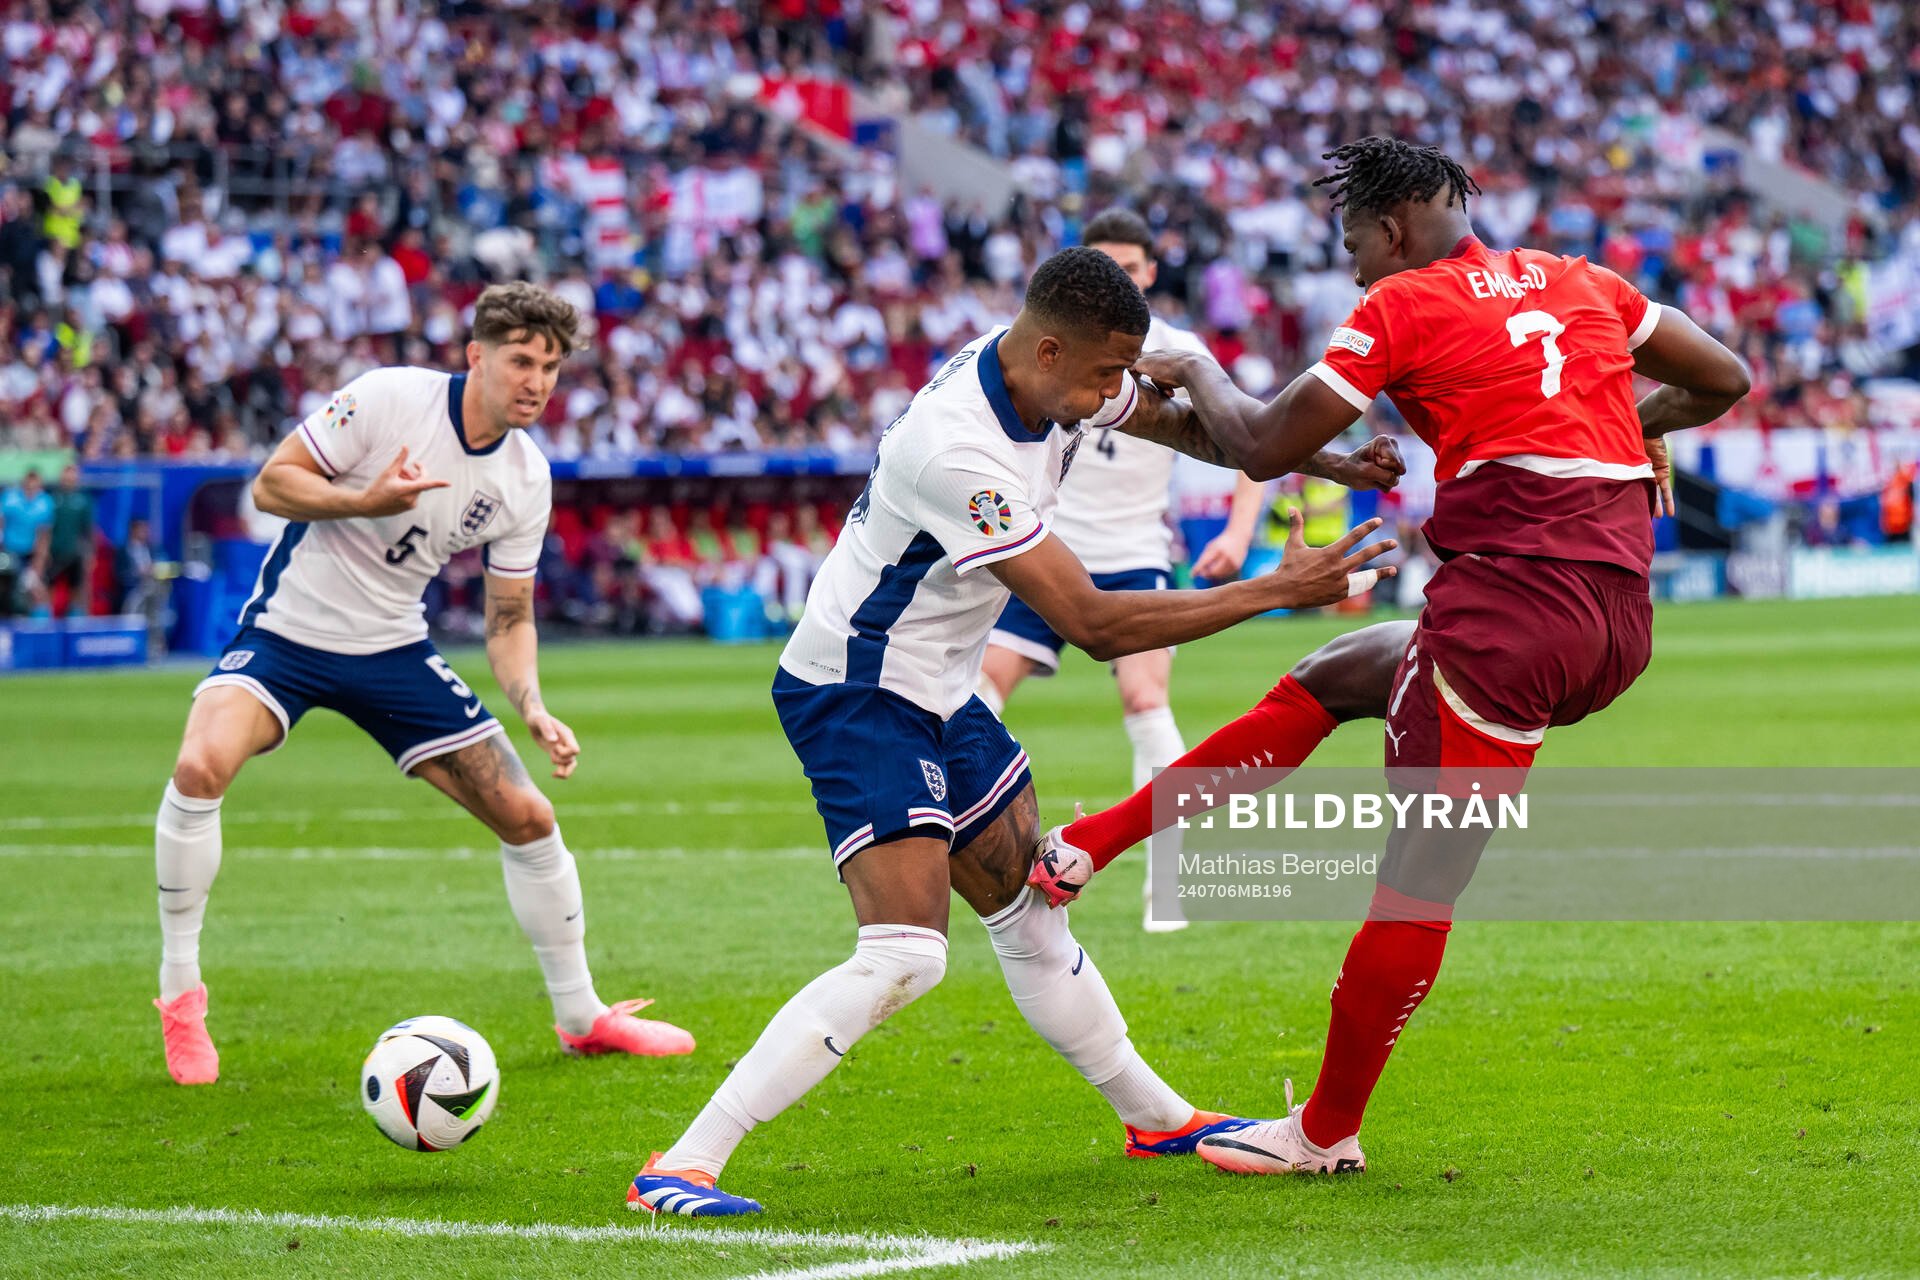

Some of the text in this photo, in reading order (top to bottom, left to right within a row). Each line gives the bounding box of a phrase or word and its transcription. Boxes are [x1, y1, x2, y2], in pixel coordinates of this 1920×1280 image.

[1506, 310, 1567, 399] 7
[1097, 428, 1115, 460] 4
[386, 524, 428, 564] 5
[424, 654, 473, 699] 5
